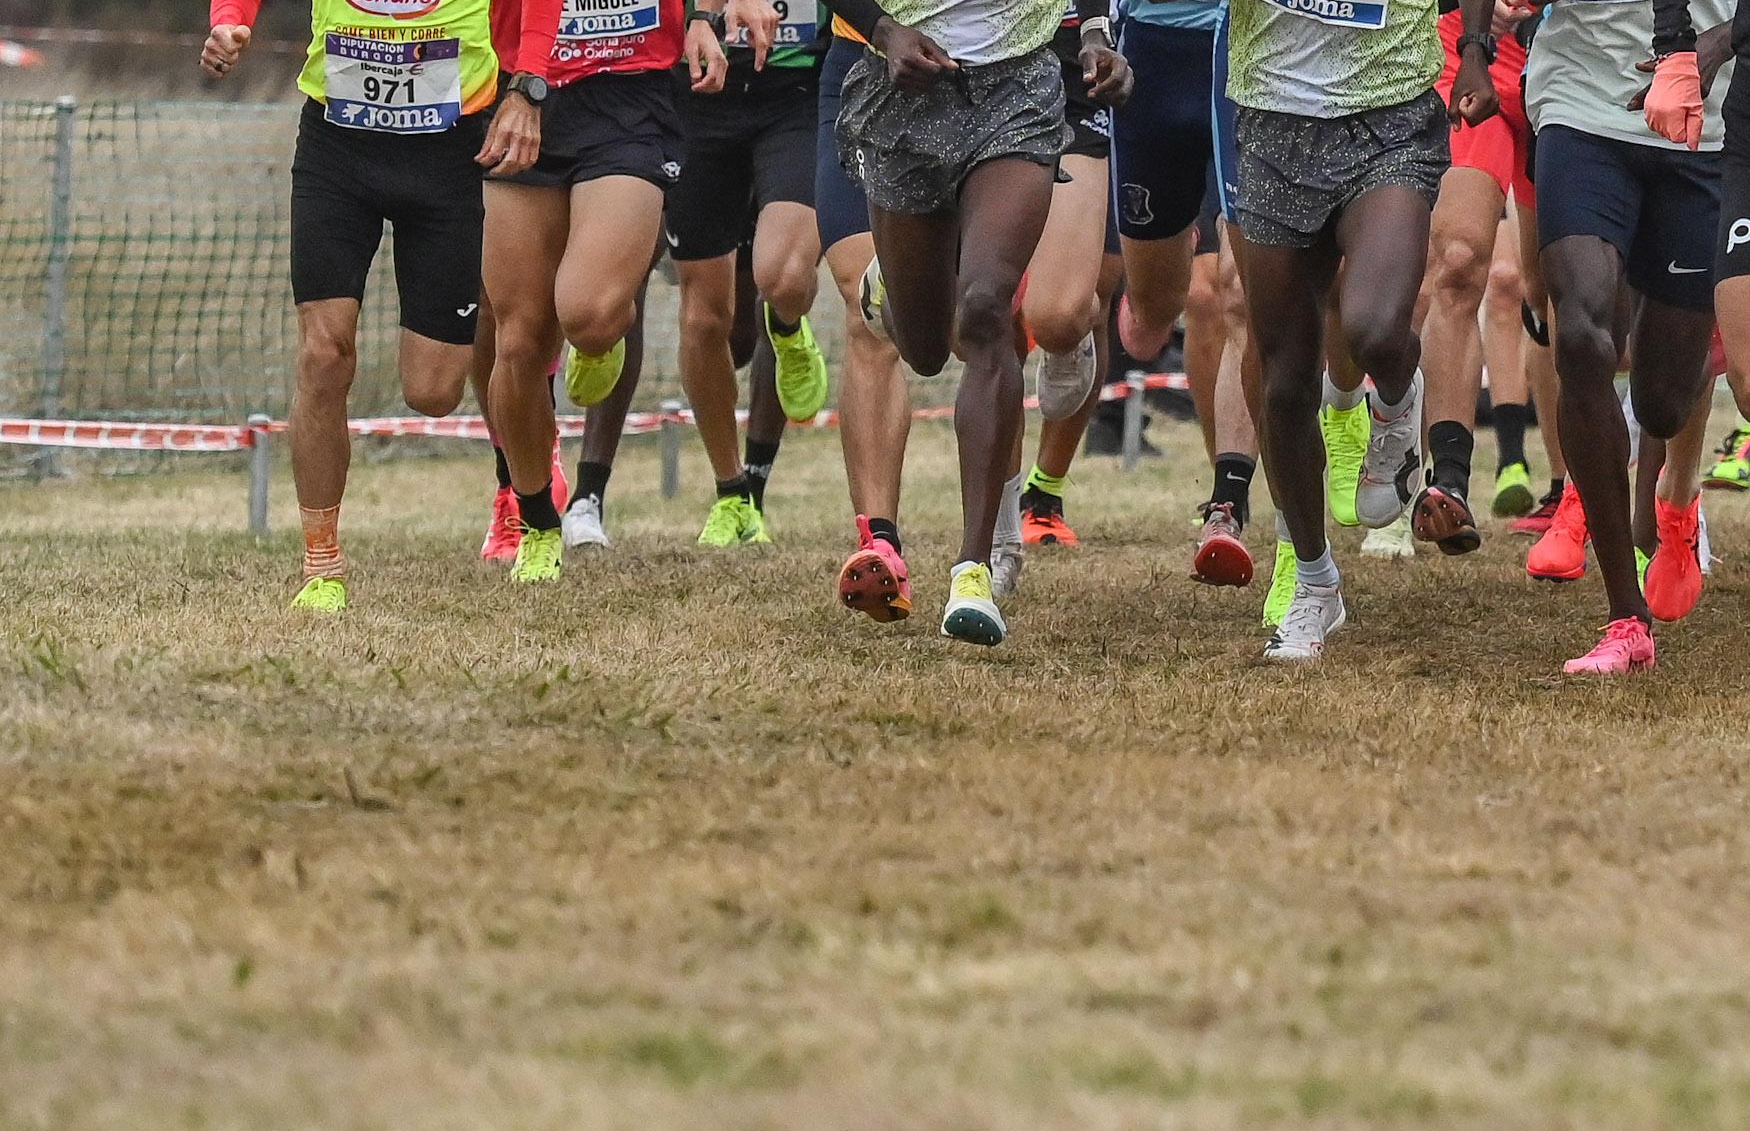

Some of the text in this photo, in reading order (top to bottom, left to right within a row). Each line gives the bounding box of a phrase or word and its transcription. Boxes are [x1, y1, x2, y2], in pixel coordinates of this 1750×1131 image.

[369, 28, 396, 40] BIEN
[400, 28, 406, 41] Y
[411, 27, 446, 41] CORRE
[339, 37, 404, 54] DIPUTACIÓN
[340, 47, 404, 63] BURGOS
[360, 62, 403, 76] Ibercaja
[363, 76, 415, 104] 971
